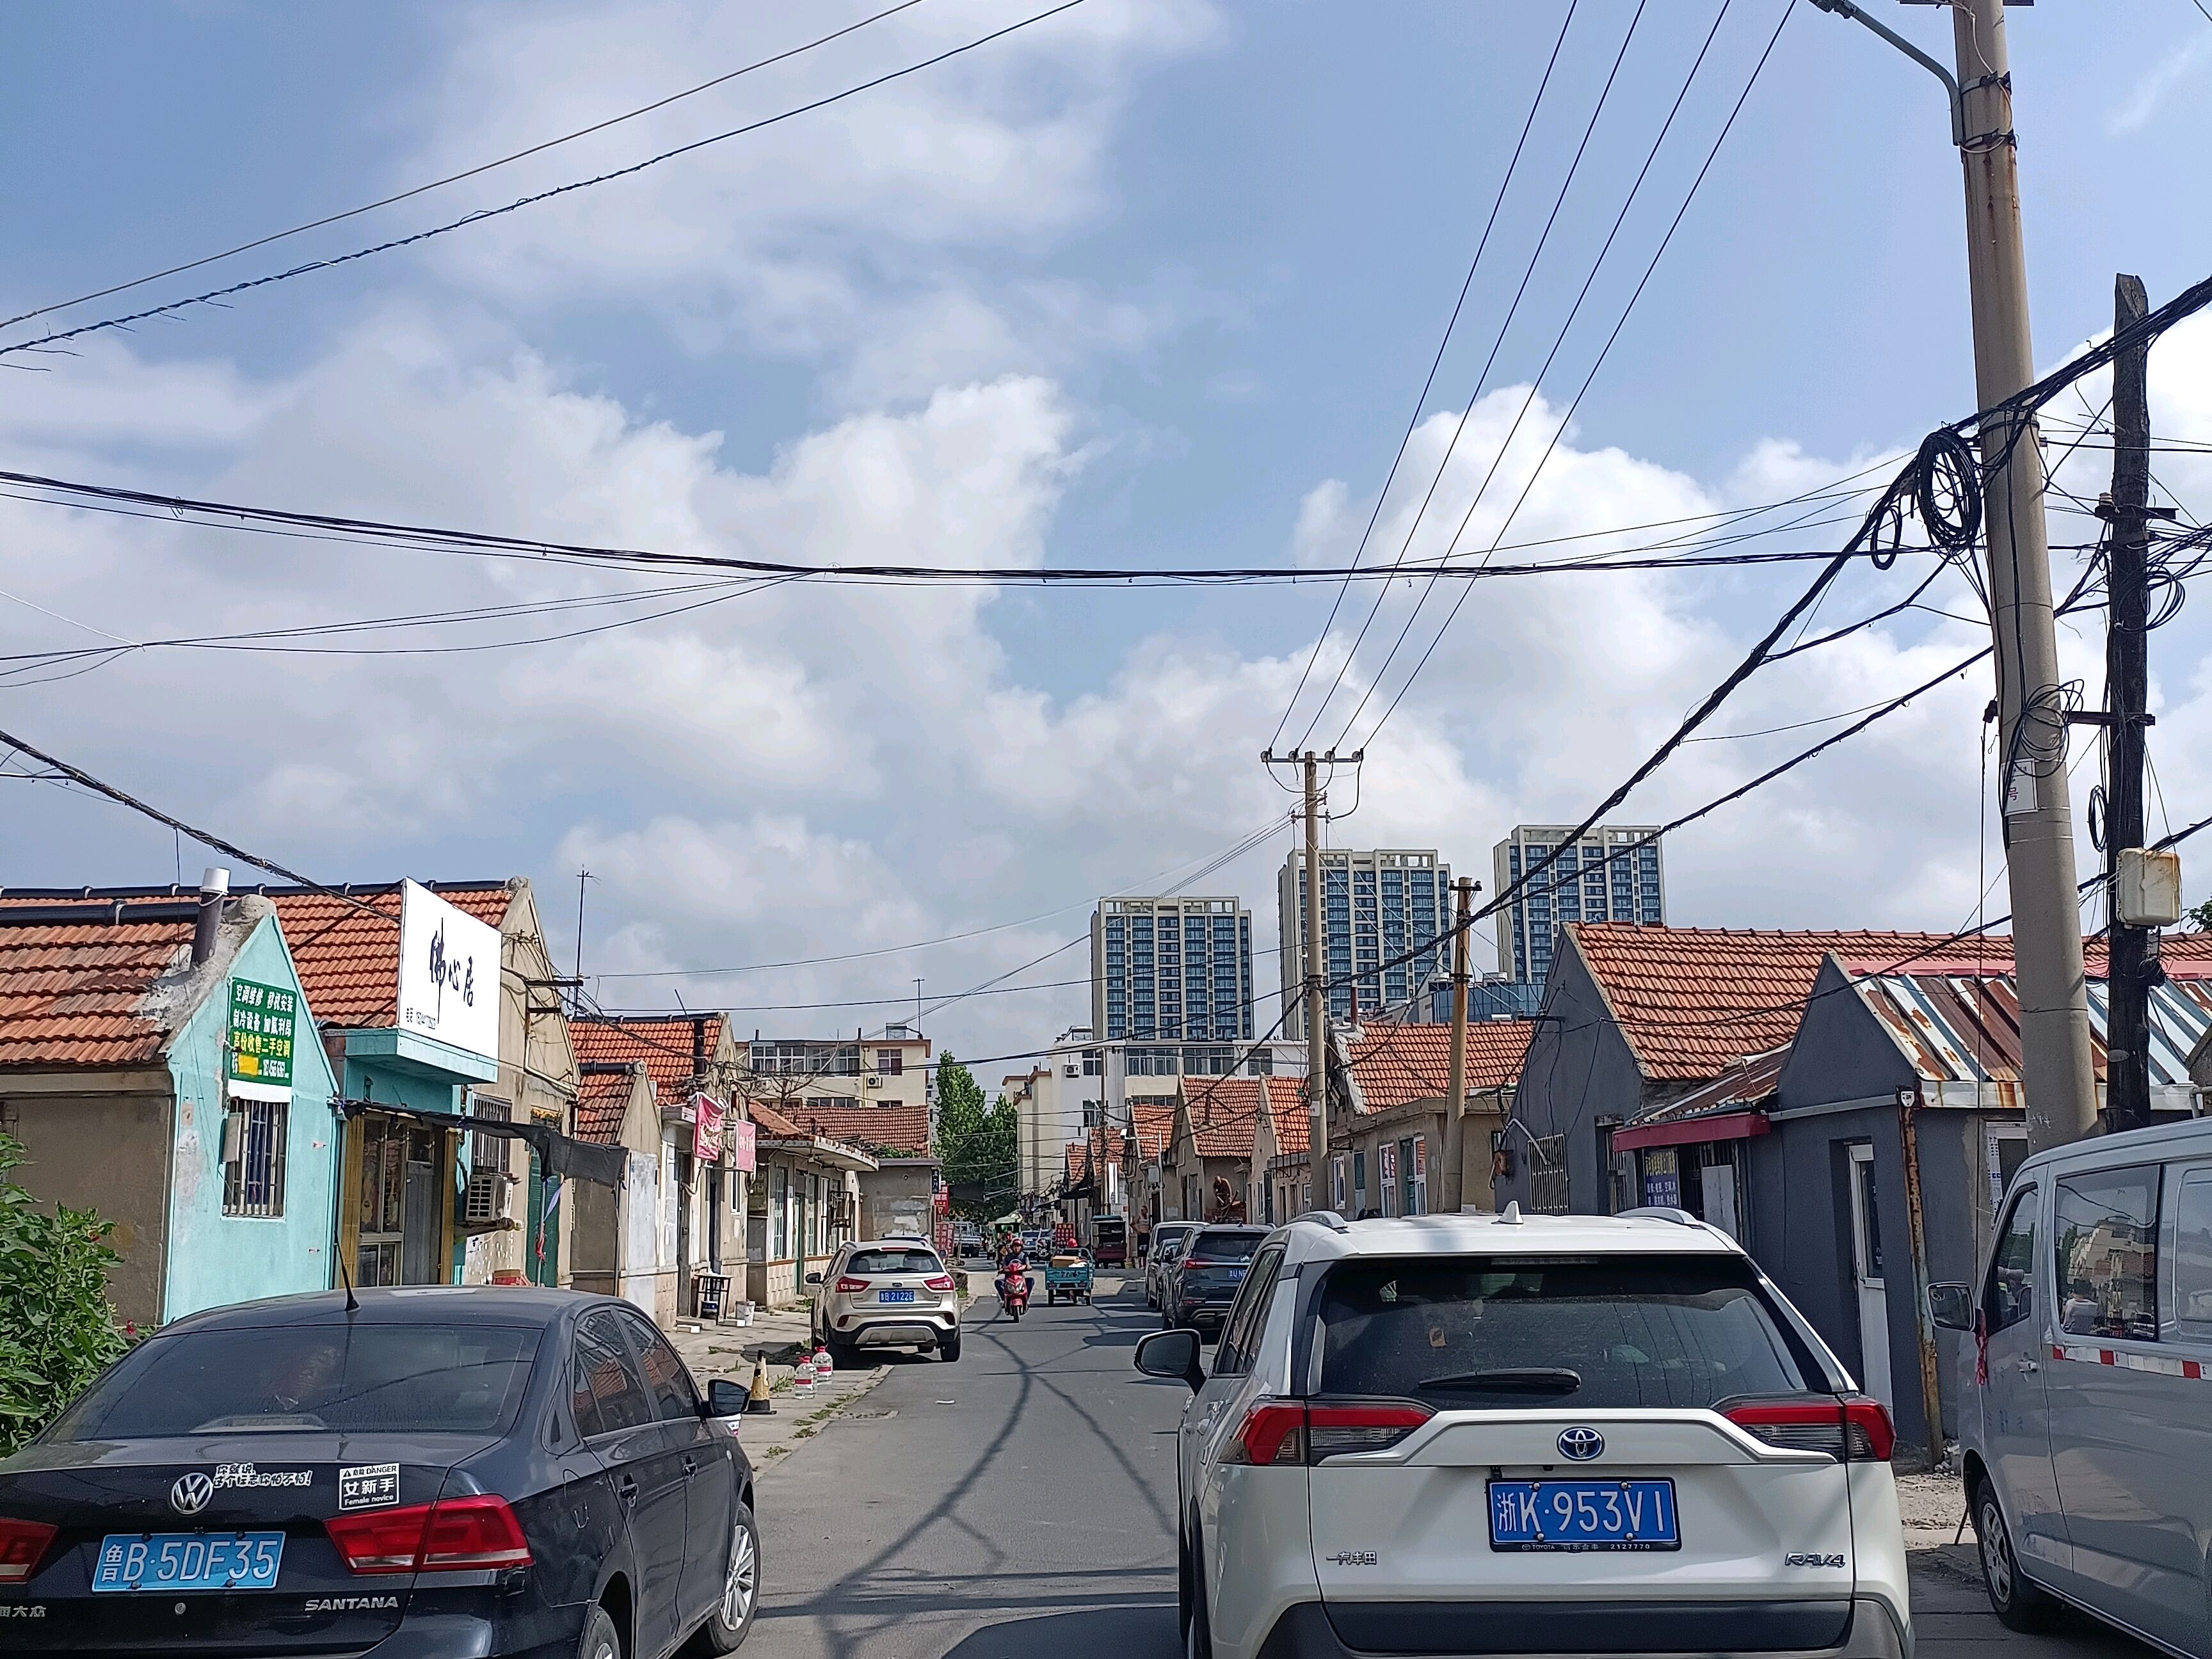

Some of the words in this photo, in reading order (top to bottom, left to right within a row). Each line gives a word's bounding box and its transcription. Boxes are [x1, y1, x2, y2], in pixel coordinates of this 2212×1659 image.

[236, 984, 264, 1006] 空调维修
[266, 991, 293, 1013] 移机安装
[233, 1008, 260, 1032] 制冷设备
[263, 1014, 292, 1037] 加氟利昂
[234, 1031, 291, 1058] 高价收售二手空调
[366, 1465, 397, 1475] DANGER
[344, 1477, 395, 1497] 女新手
[344, 1496, 370, 1506] Female
[372, 1494, 394, 1503] novice
[101, 1541, 278, 1582] 鲁B·5DF35
[1326, 1551, 1377, 1566] 一汽丰田
[1784, 1552, 1847, 1568] RAV4
[305, 1597, 398, 1611] SANTANA
